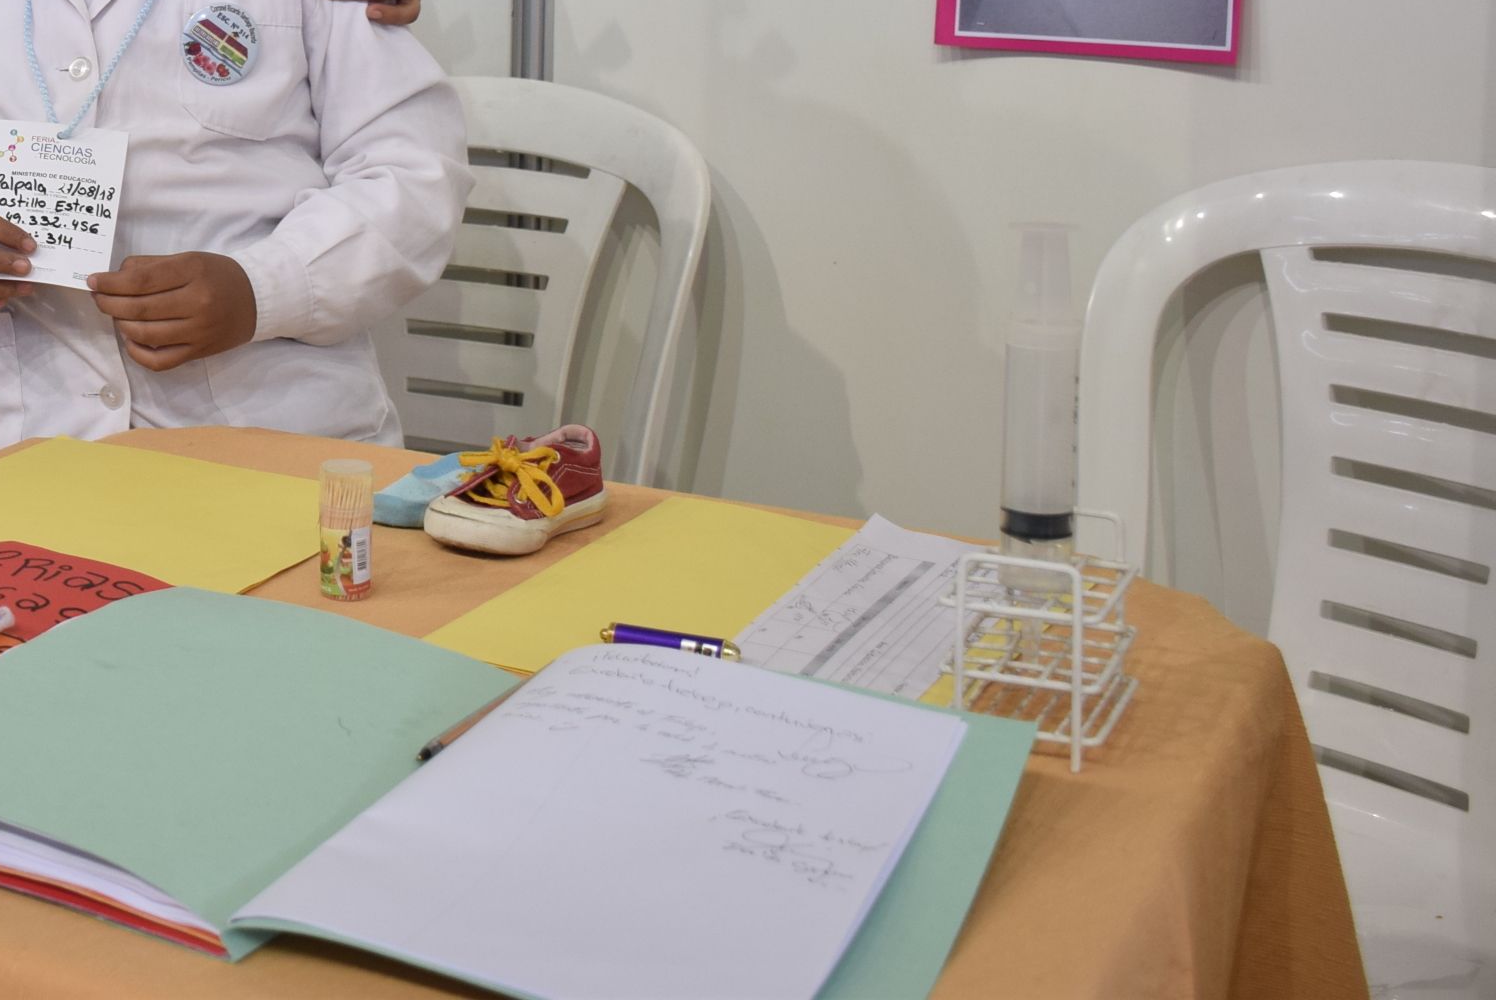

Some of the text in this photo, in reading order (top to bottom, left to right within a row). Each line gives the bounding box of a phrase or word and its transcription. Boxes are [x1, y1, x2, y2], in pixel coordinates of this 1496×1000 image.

[31, 135, 56, 143] FERIA
[31, 142, 93, 158] CIENCIAS
[11, 171, 47, 179] MINISTERIO
[55, 198, 112, 220] Estrella
[45, 231, 74, 250] 314
